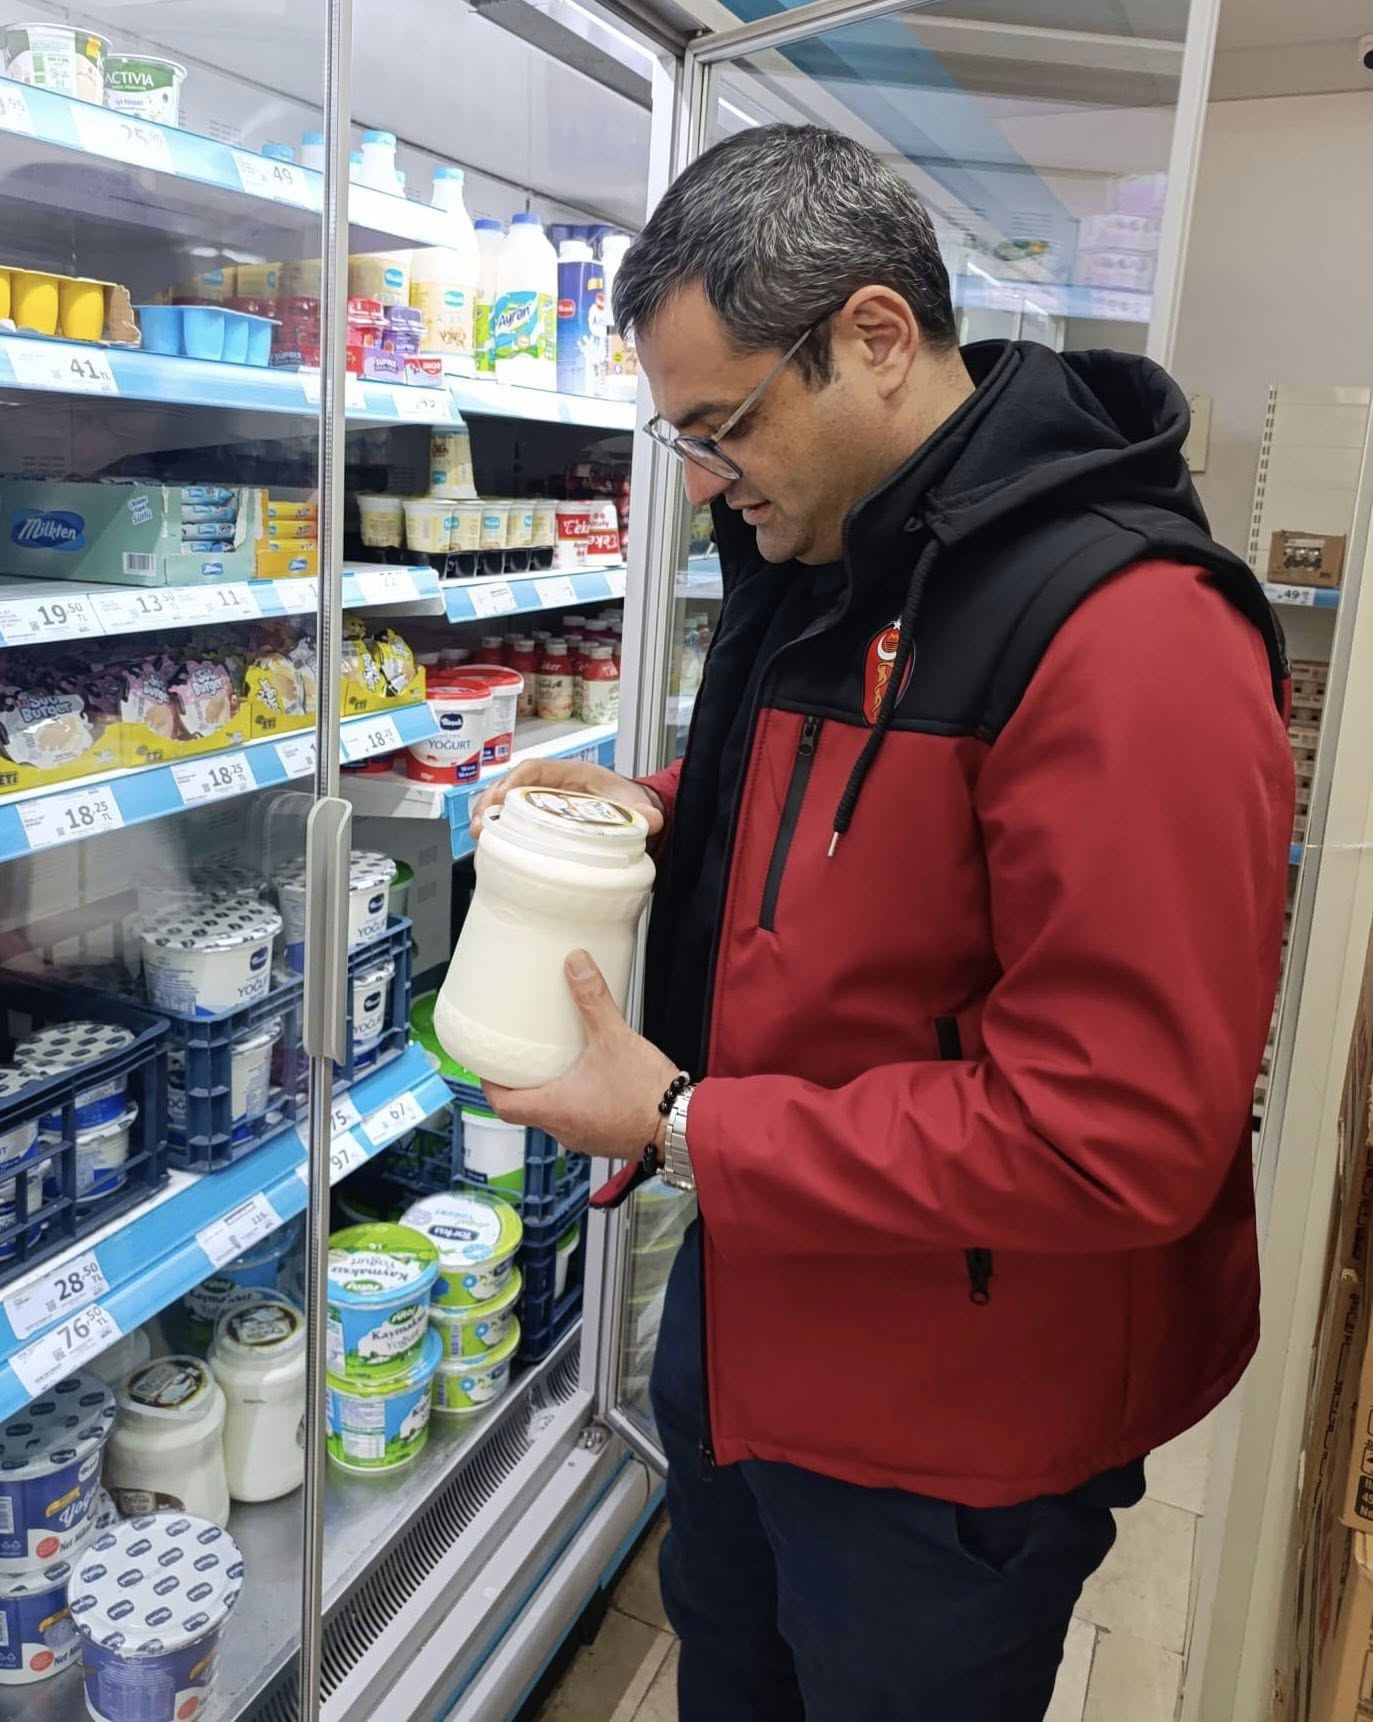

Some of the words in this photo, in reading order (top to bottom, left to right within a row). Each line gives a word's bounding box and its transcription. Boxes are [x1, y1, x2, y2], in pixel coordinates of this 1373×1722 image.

[105, 71, 155, 88] ACTIVIA
[273, 165, 293, 184] 49
[498, 304, 531, 327] Ayran
[70, 357, 100, 379] 41
[76, 613, 88, 622] TL
[20, 701, 73, 723] Burger
[101, 812, 112, 821] TL
[331, 1149, 349, 1170] 97
[90, 1273, 103, 1283] TL
[96, 1316, 108, 1327] TL
